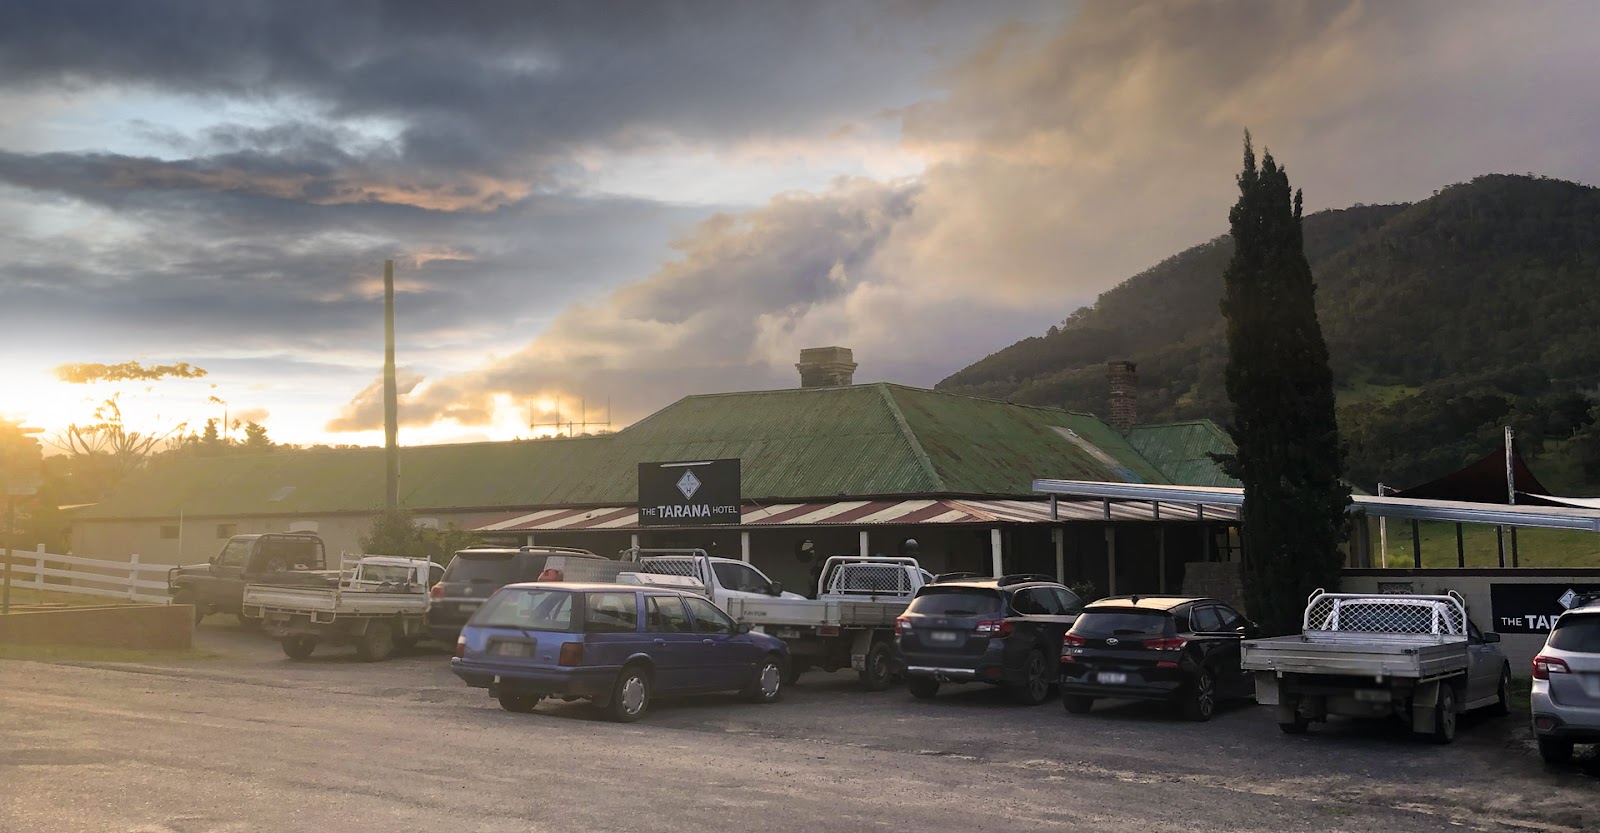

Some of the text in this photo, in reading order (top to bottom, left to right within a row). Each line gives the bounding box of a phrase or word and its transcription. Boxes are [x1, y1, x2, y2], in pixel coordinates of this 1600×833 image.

[641, 504, 738, 518] THE TARANA HOTEL
[1500, 617, 1523, 626] THE
